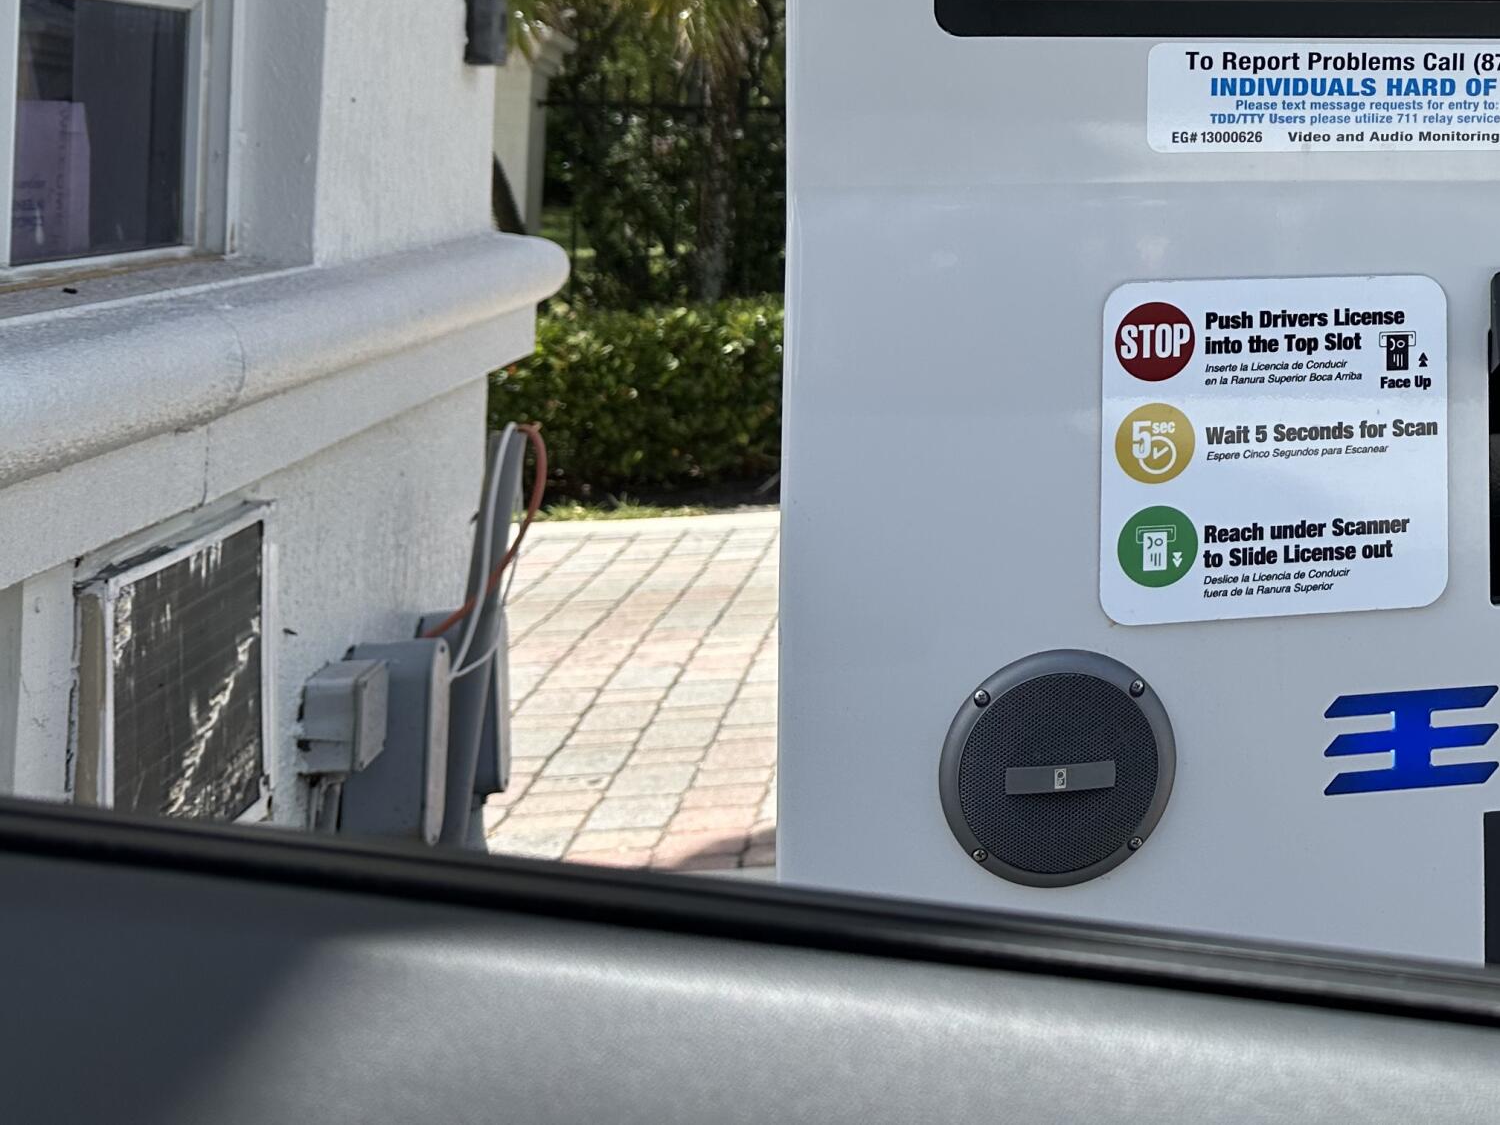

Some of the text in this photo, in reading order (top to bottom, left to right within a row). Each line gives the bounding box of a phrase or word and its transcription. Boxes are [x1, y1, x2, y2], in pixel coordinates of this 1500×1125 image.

[1185, 51, 1213, 70] To
[1223, 52, 1300, 74] Report
[1308, 52, 1415, 71] Problems
[1423, 52, 1464, 71] Call
[1211, 78, 1376, 96] INDIVIDUALS
[1387, 78, 1456, 96] HARD
[1466, 78, 1497, 97] OF
[1236, 99, 1277, 110] Please
[1281, 100, 1306, 110] text
[1310, 101, 1366, 112] message
[1370, 100, 1423, 112] requests
[1427, 99, 1444, 110] for
[1448, 100, 1479, 112] entry
[1483, 100, 1499, 110] to:
[1210, 113, 1265, 124] TDD/TTY
[1269, 113, 1306, 124] Users
[1310, 113, 1351, 126] please
[1355, 113, 1393, 124] utilize
[1397, 113, 1417, 123] 711
[1423, 113, 1453, 126] relay
[1457, 113, 1500, 124] service
[1172, 131, 1263, 143] EG# 13000626
[1288, 131, 1330, 142] Video
[1336, 131, 1364, 142] and
[1369, 131, 1413, 142] Audio
[1419, 131, 1500, 143] Monitoring
[1205, 308, 1405, 330] Push Drivers License
[1120, 323, 1191, 360] STOP
[1205, 332, 1362, 355] into the Top Slot
[1205, 359, 1348, 373] Inserte la Licencia de Conducir
[1205, 372, 1362, 386] en la Ranura Superior Boca Arriba
[1380, 375, 1431, 390] Face Up
[1131, 420, 1175, 460] 5 sec
[1205, 419, 1438, 445] Wait 5 Seconds for Scan
[1206, 445, 1389, 462] Espere Cinco Segundos para Escanear
[1204, 518, 1410, 544] Reach under Scanner
[1203, 540, 1393, 568] to Slide License out
[1203, 568, 1351, 585] Deslice la Licencia de Conducir
[1203, 582, 1334, 598] fuera de la Ranura Superior
